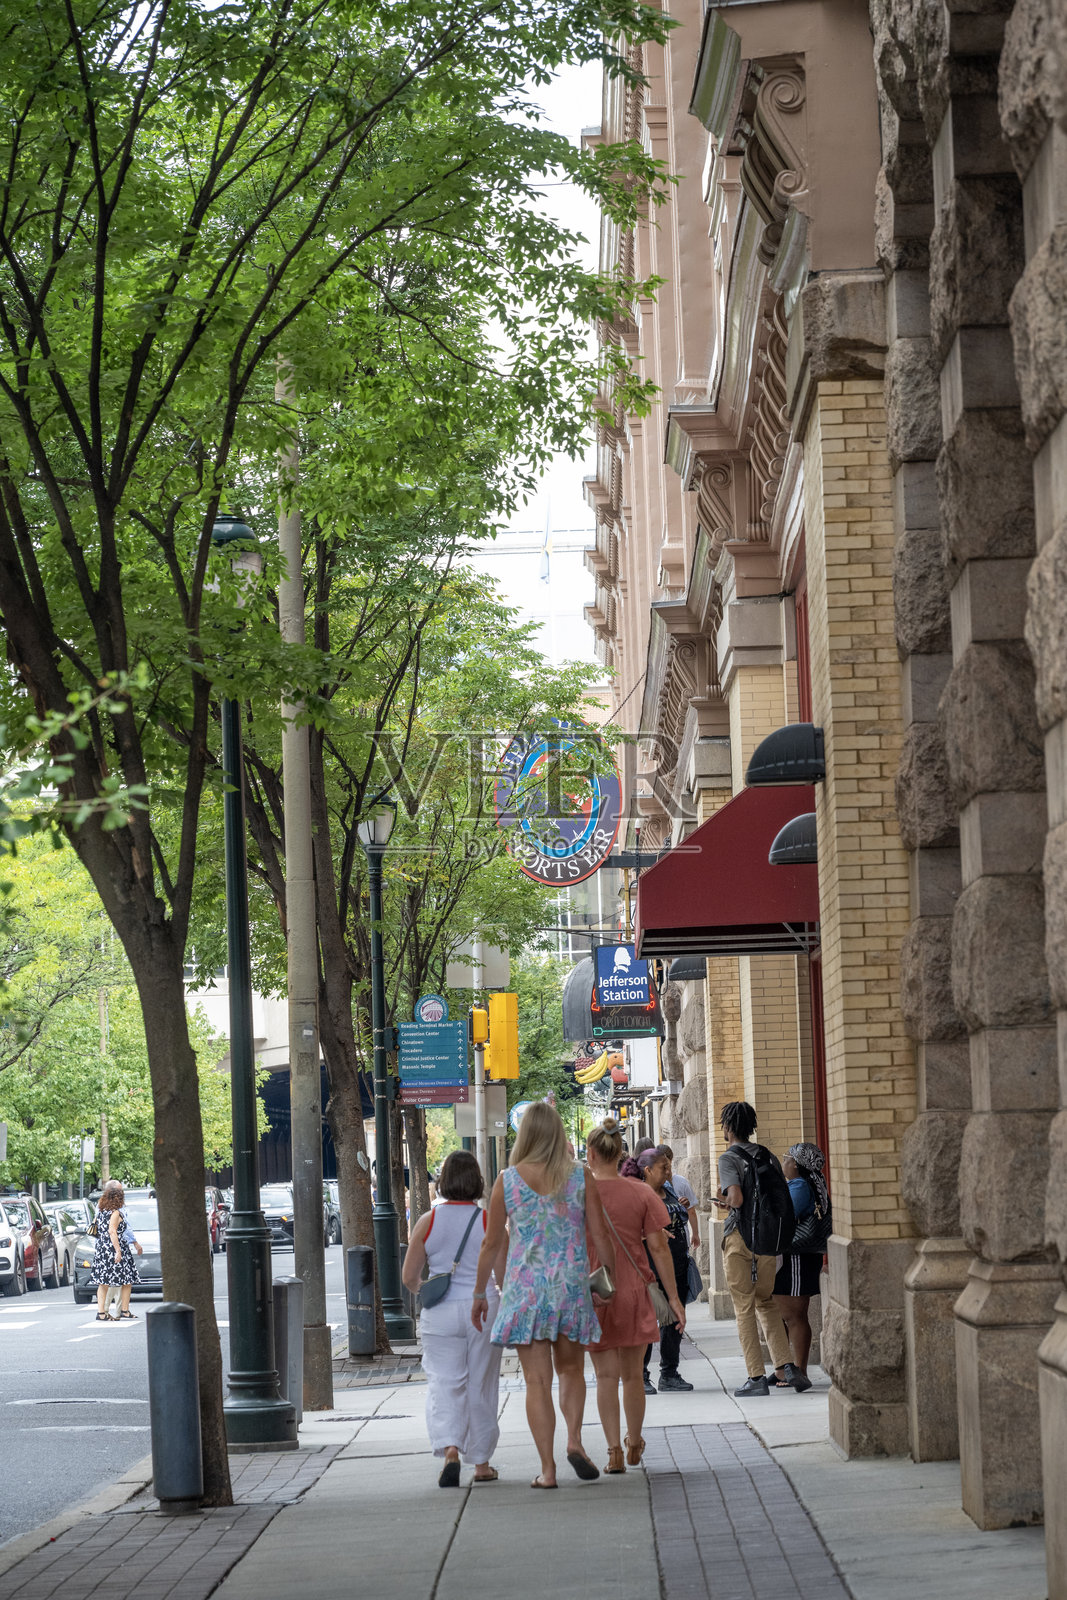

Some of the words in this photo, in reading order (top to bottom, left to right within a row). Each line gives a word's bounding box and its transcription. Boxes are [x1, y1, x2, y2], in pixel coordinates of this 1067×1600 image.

[584, 828, 614, 867] BAR
[598, 975, 648, 988] Jefferson
[603, 989, 644, 1001] Station
